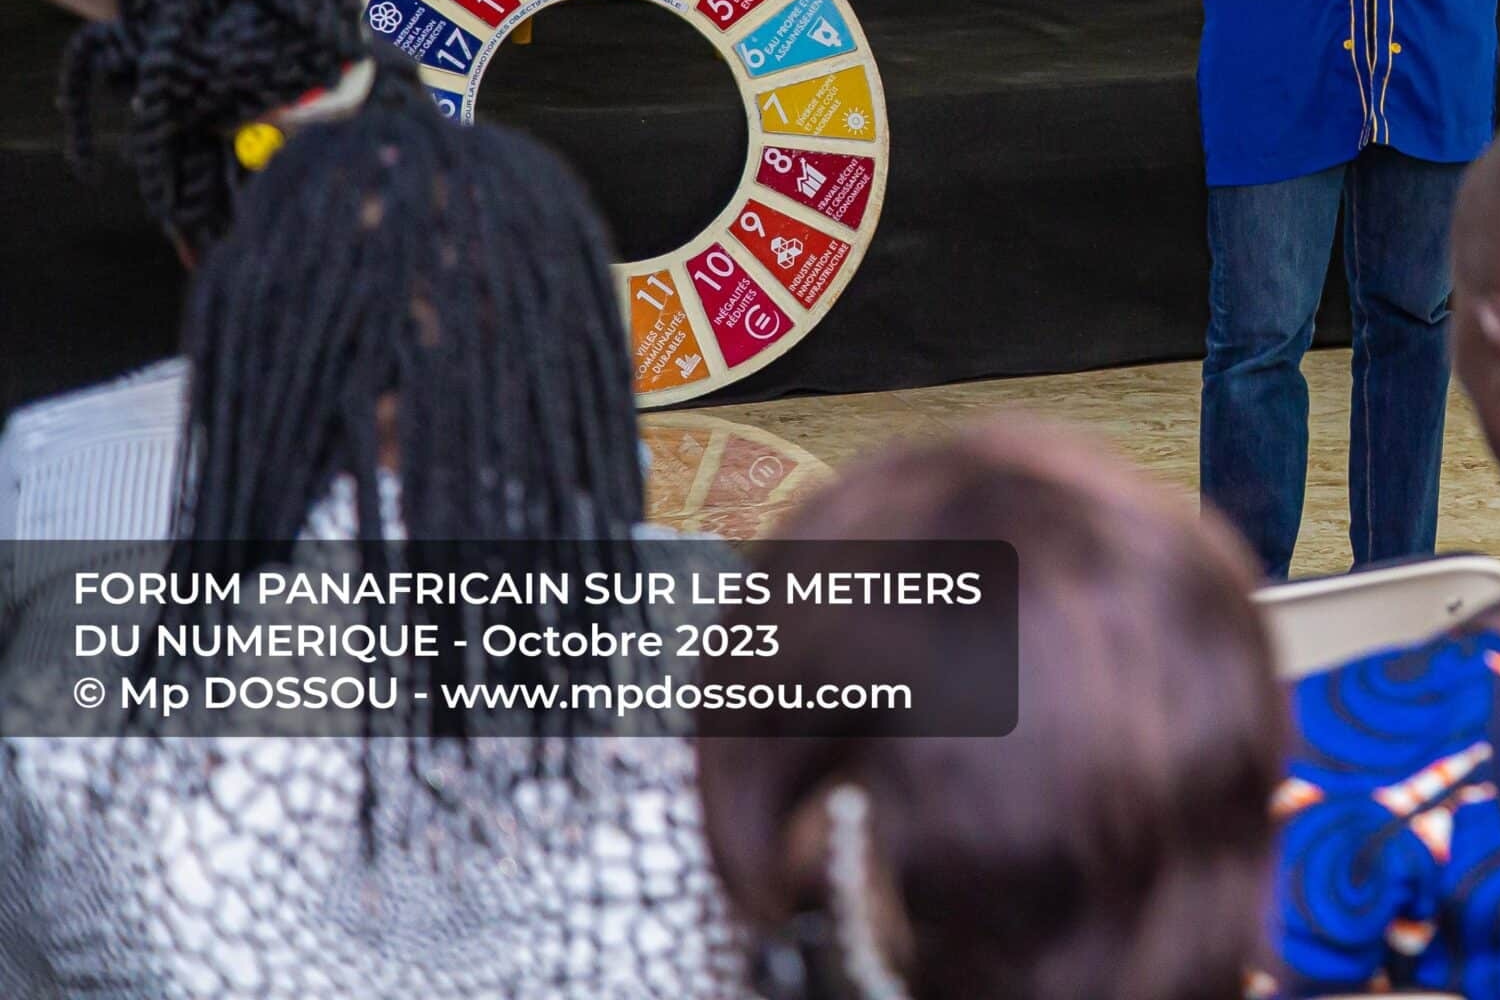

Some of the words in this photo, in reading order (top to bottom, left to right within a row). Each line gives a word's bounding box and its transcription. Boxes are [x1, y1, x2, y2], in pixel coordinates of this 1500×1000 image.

[437, 27, 472, 69] 17
[764, 36, 779, 55] EAU
[776, 8, 802, 38] PROPRE
[467, 87, 475, 98] LA
[471, 38, 497, 87] PROMOTION
[495, 24, 510, 39] DES
[741, 43, 765, 68] 6
[762, 92, 789, 124] 7
[764, 148, 792, 173] 8
[817, 184, 840, 210] TRAVAIL
[837, 159, 858, 185] DÉCENT
[826, 206, 834, 216] ET
[832, 166, 866, 207] CROISSANCE
[740, 212, 766, 238] 9
[694, 252, 734, 291] 10
[789, 254, 818, 292] INDUSTRIE
[796, 252, 830, 298] INNOVATION
[828, 239, 838, 253] ET
[805, 243, 849, 304] INFRASTRUCTURE
[636, 275, 674, 310] 11
[713, 278, 750, 326] INÉGALITÉS
[726, 289, 757, 328] RÉDUITES
[635, 330, 658, 357] VILLES
[654, 319, 665, 331] ET
[652, 331, 686, 375] DURABLES
